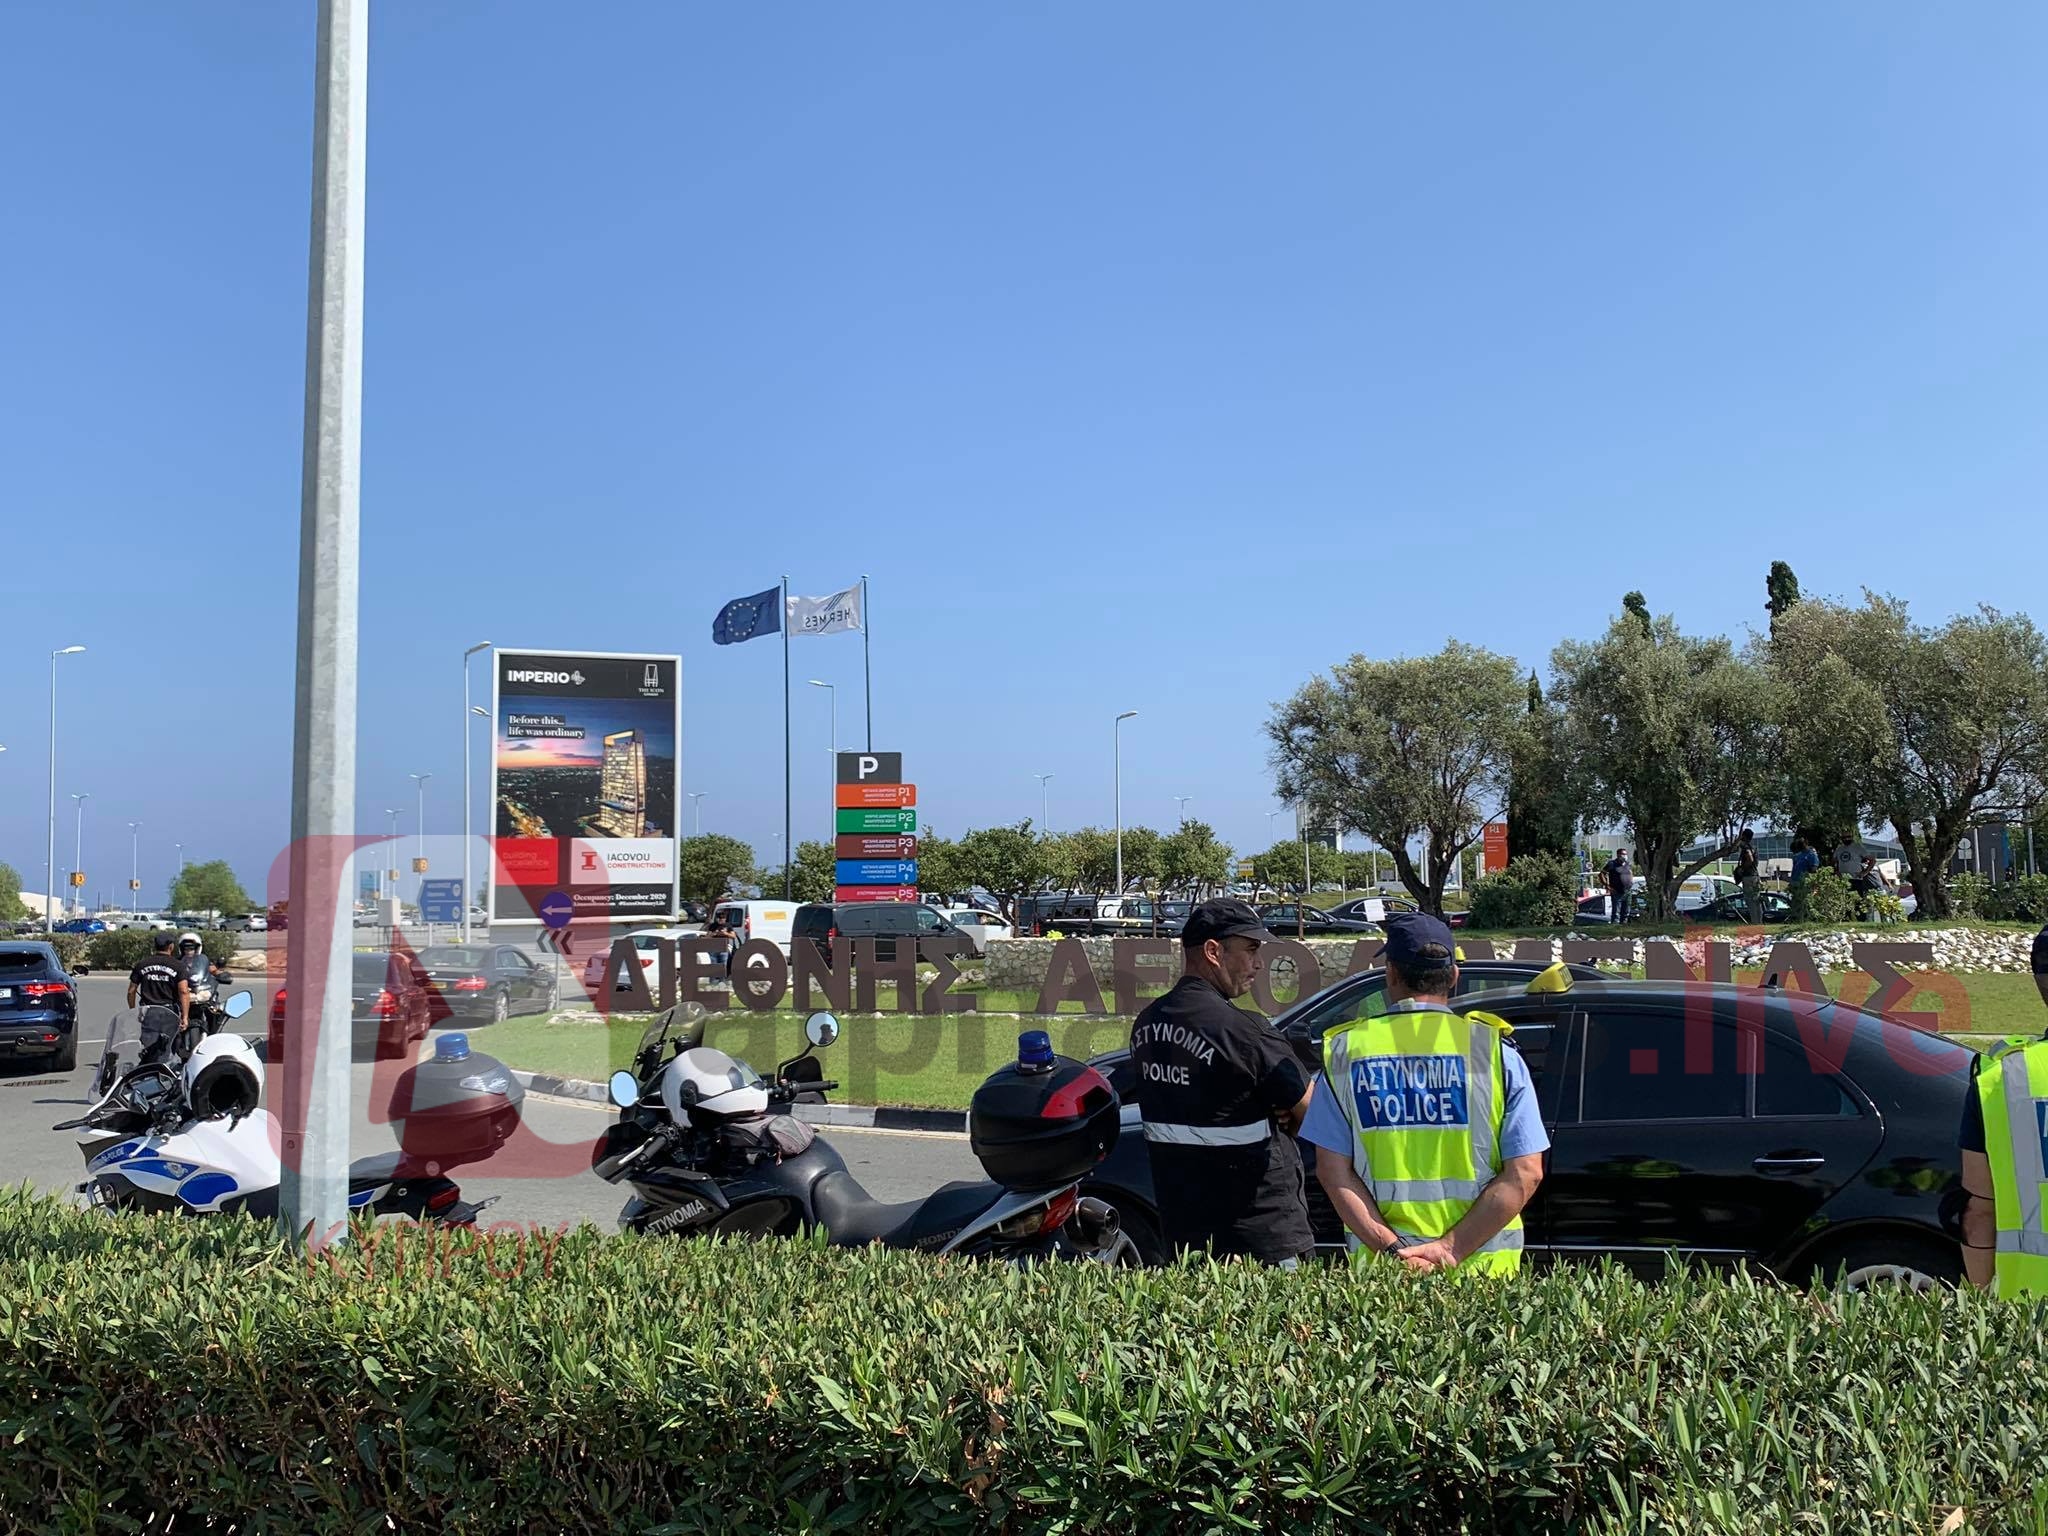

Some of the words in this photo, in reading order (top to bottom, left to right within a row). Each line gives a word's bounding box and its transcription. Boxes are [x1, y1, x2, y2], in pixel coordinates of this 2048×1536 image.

[507, 670, 570, 684] IMPERIO
[508, 715, 540, 726] Before
[508, 727, 523, 736] life
[526, 729, 544, 737] was
[545, 728, 585, 739] ordinary
[858, 756, 879, 780] P
[898, 787, 911, 797] P1
[898, 812, 914, 822] P2
[898, 838, 914, 848] P3
[607, 852, 651, 862] IACOVOU
[898, 863, 915, 874] P4
[573, 894, 614, 902] Occupancy:
[616, 893, 649, 901] December
[898, 889, 914, 899] P5
[147, 974, 170, 982] POLICE
[606, 936, 978, 1013] ΔΙΕΘΝΗΣ
[1142, 1061, 1190, 1086] POLICE
[1356, 1058, 1463, 1095] ΑΣΤΥΝΟΜΙΑ
[1369, 1092, 1454, 1124] POLICE
